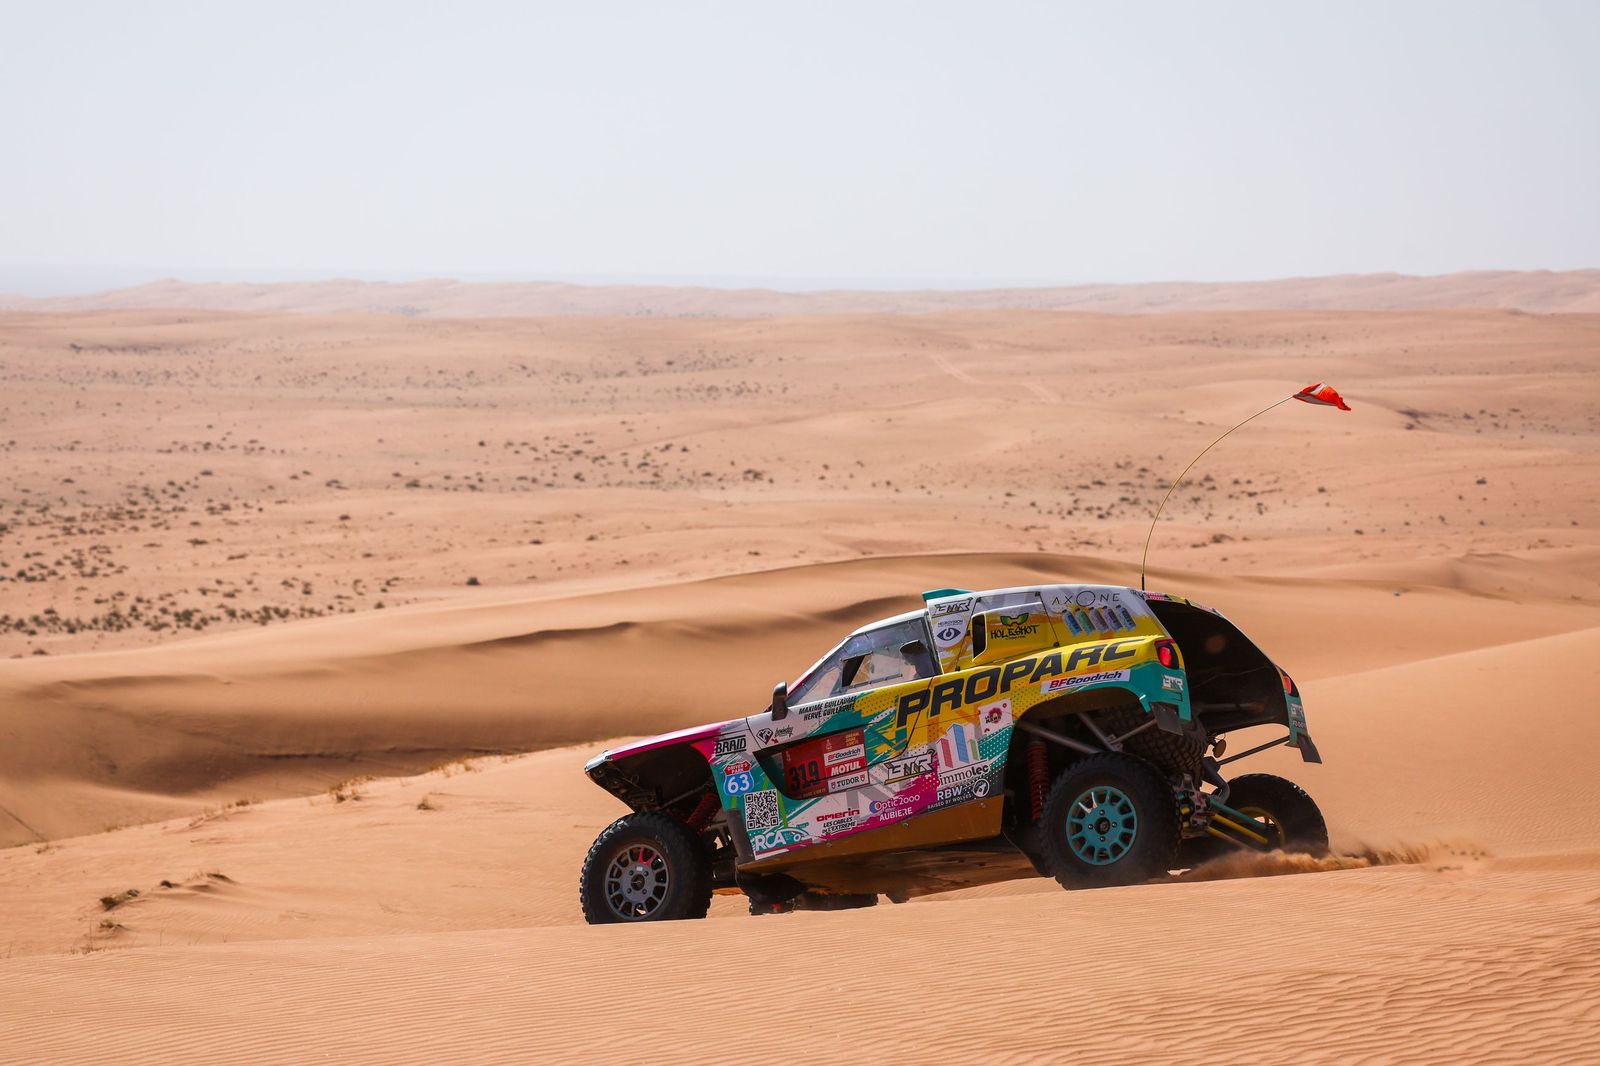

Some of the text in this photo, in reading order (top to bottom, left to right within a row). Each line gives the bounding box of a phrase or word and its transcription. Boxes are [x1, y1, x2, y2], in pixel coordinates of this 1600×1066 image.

[1052, 591, 1120, 606] AXONE
[991, 625, 1040, 639] HOLESHOT
[896, 639, 1141, 728] PROPARC
[1050, 671, 1122, 688] BFGoodrich
[799, 696, 857, 714] MAXIME GUILLAUME
[716, 738, 747, 753] BRAID
[828, 748, 861, 761] BFGoodrich
[831, 761, 862, 776] MOTUL
[940, 764, 989, 785] immolec
[728, 773, 750, 793] 63
[789, 761, 819, 792] 319
[837, 777, 859, 787] TUDOR
[937, 785, 962, 801] RBW
[952, 794, 972, 803] WOLVES
[874, 794, 921, 812] Optic 2000
[879, 807, 913, 822] AUBIERE
[823, 817, 853, 828] LES CABLES
